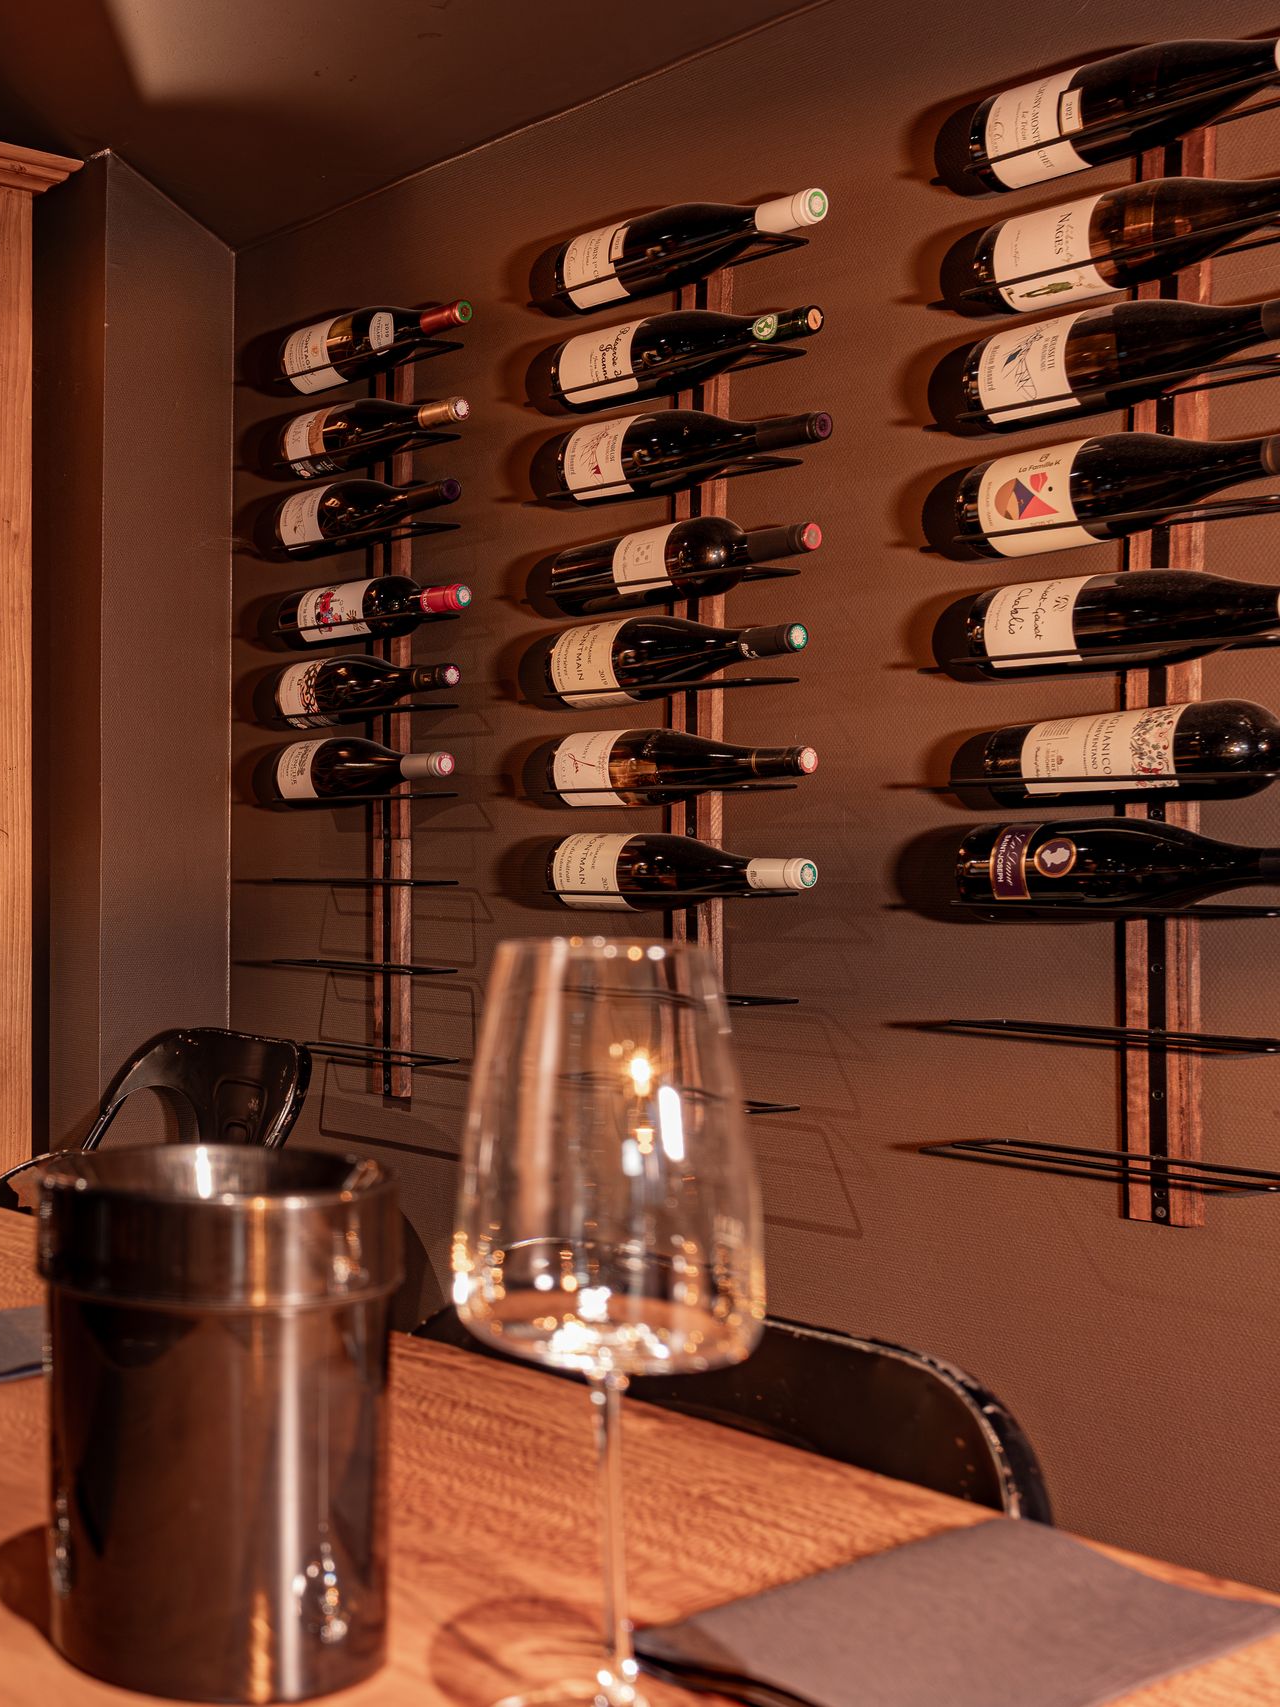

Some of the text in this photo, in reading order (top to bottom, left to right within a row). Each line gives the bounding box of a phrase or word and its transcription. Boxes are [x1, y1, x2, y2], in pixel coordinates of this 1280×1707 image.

[1053, 212, 1072, 255] NAGES
[1007, 587, 1032, 635] Chablis
[587, 634, 598, 665] DOMAINE
[598, 669, 609, 686] 2019
[1101, 714, 1125, 775] AGLIANICO
[590, 842, 605, 870] DOMAINE
[997, 834, 1012, 883] SAINT-JOSEPH
